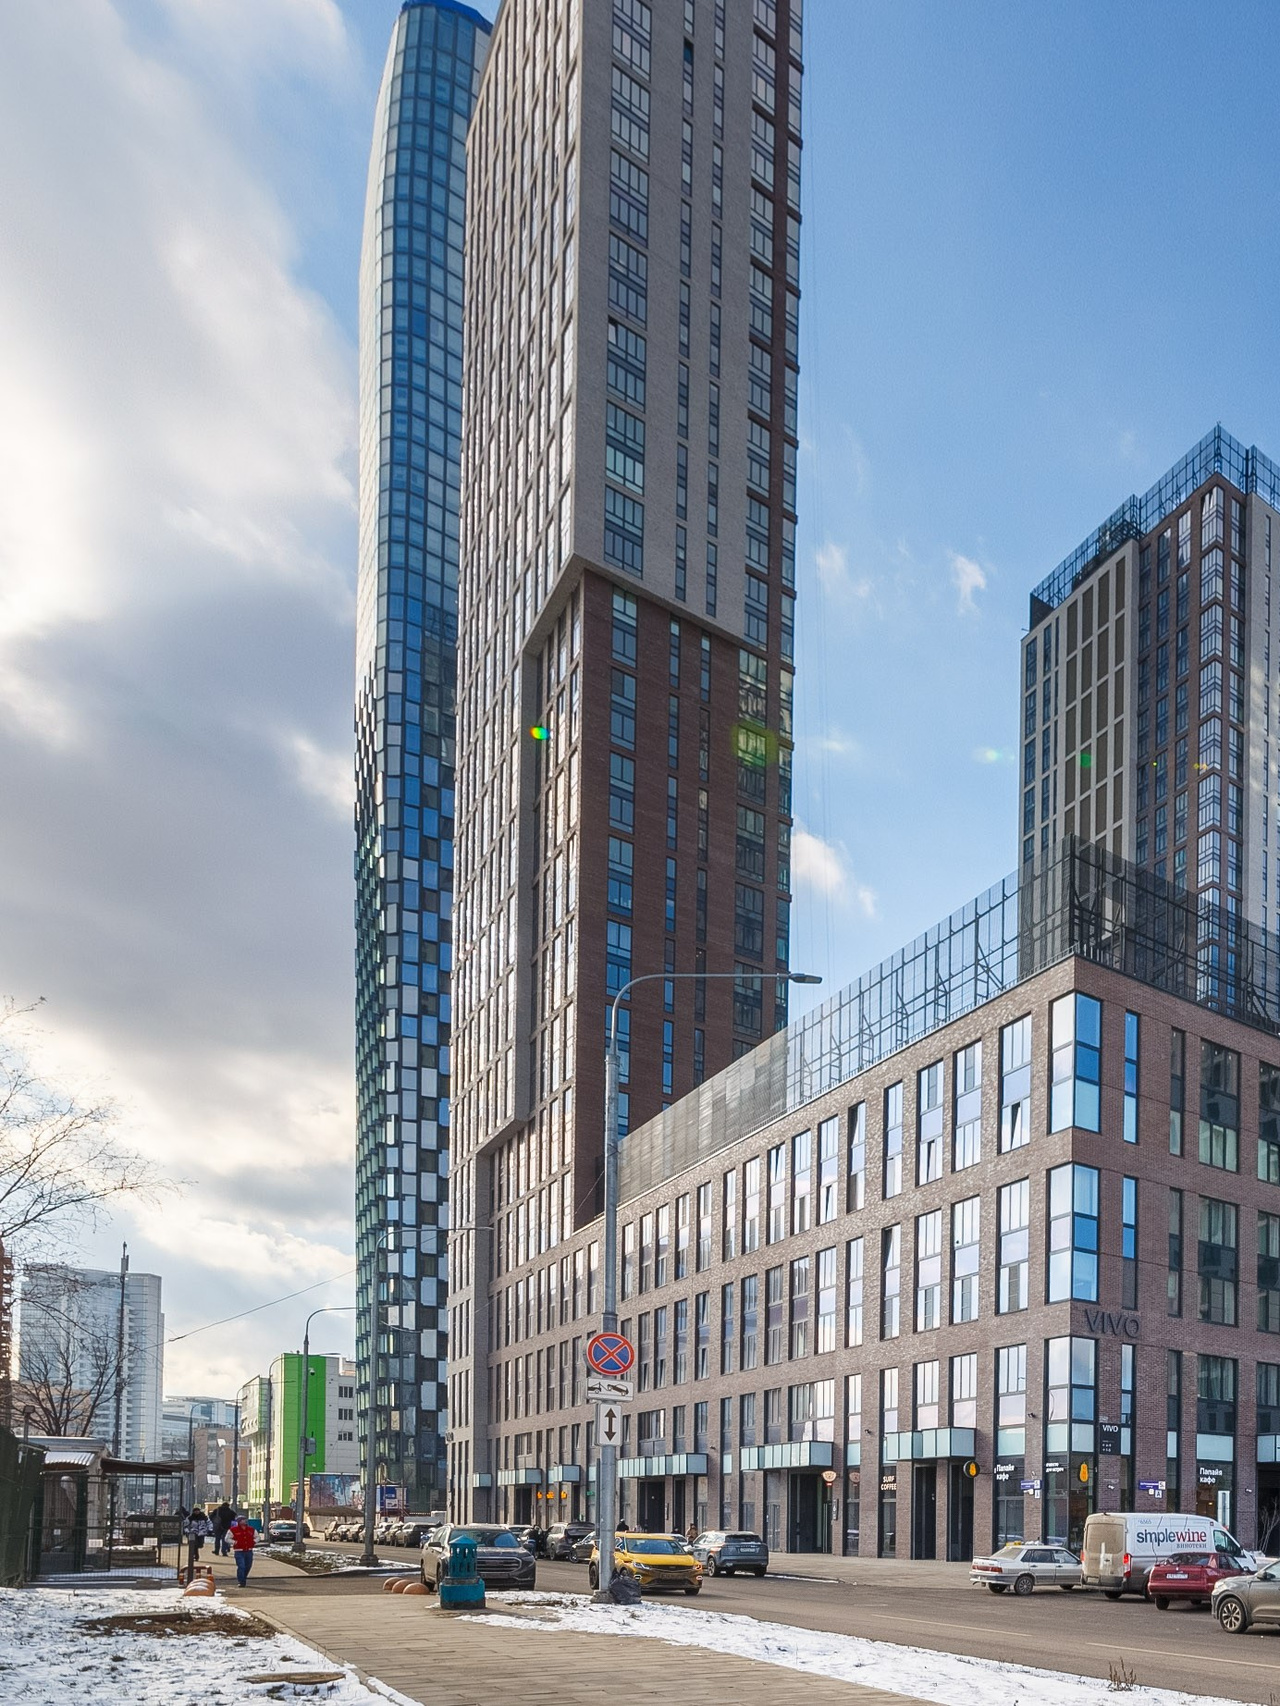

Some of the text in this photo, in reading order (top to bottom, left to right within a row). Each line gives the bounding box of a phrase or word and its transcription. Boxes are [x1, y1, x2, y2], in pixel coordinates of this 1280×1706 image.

[1085, 1308, 1141, 1338] VIVO
[1102, 1425, 1119, 1433] VIVO
[1200, 1467, 1223, 1476] Папайя
[1136, 1528, 1207, 1546] simplewine
